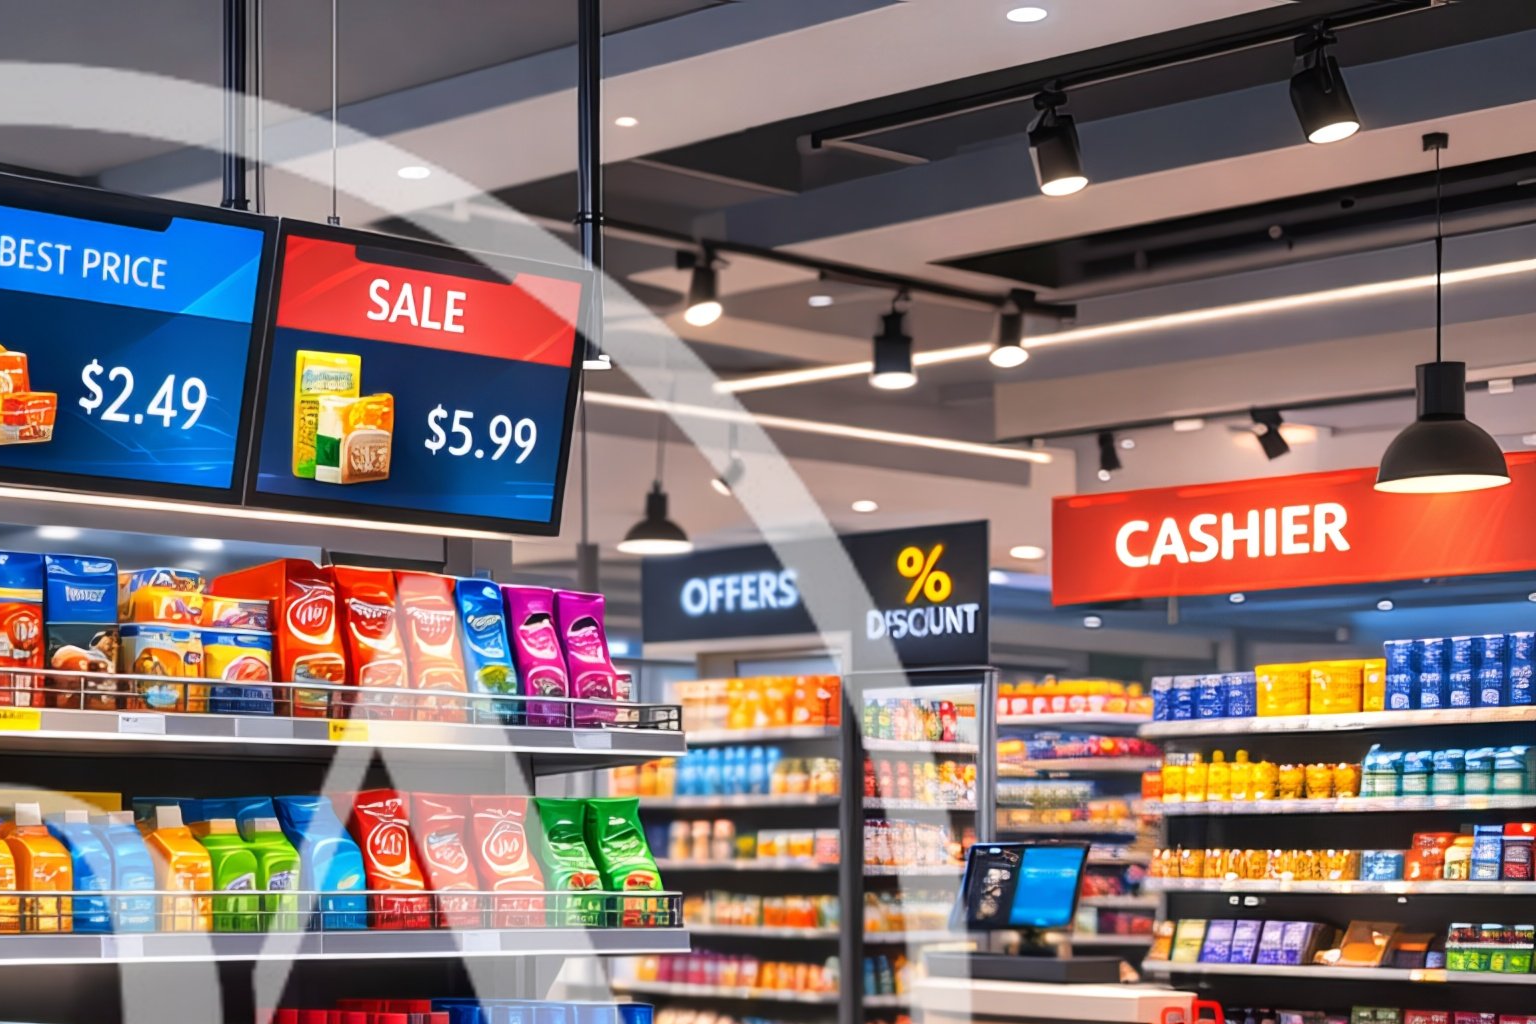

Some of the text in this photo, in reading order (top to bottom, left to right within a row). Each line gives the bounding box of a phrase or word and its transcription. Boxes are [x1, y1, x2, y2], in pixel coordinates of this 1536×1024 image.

[0, 235, 167, 289] BEST PRICE
[366, 278, 467, 333] SALE
[78, 358, 208, 430] $2.49
[424, 403, 537, 464] $5.99
[1115, 502, 1350, 568] CASHIER
[681, 569, 799, 616] OFFERS
